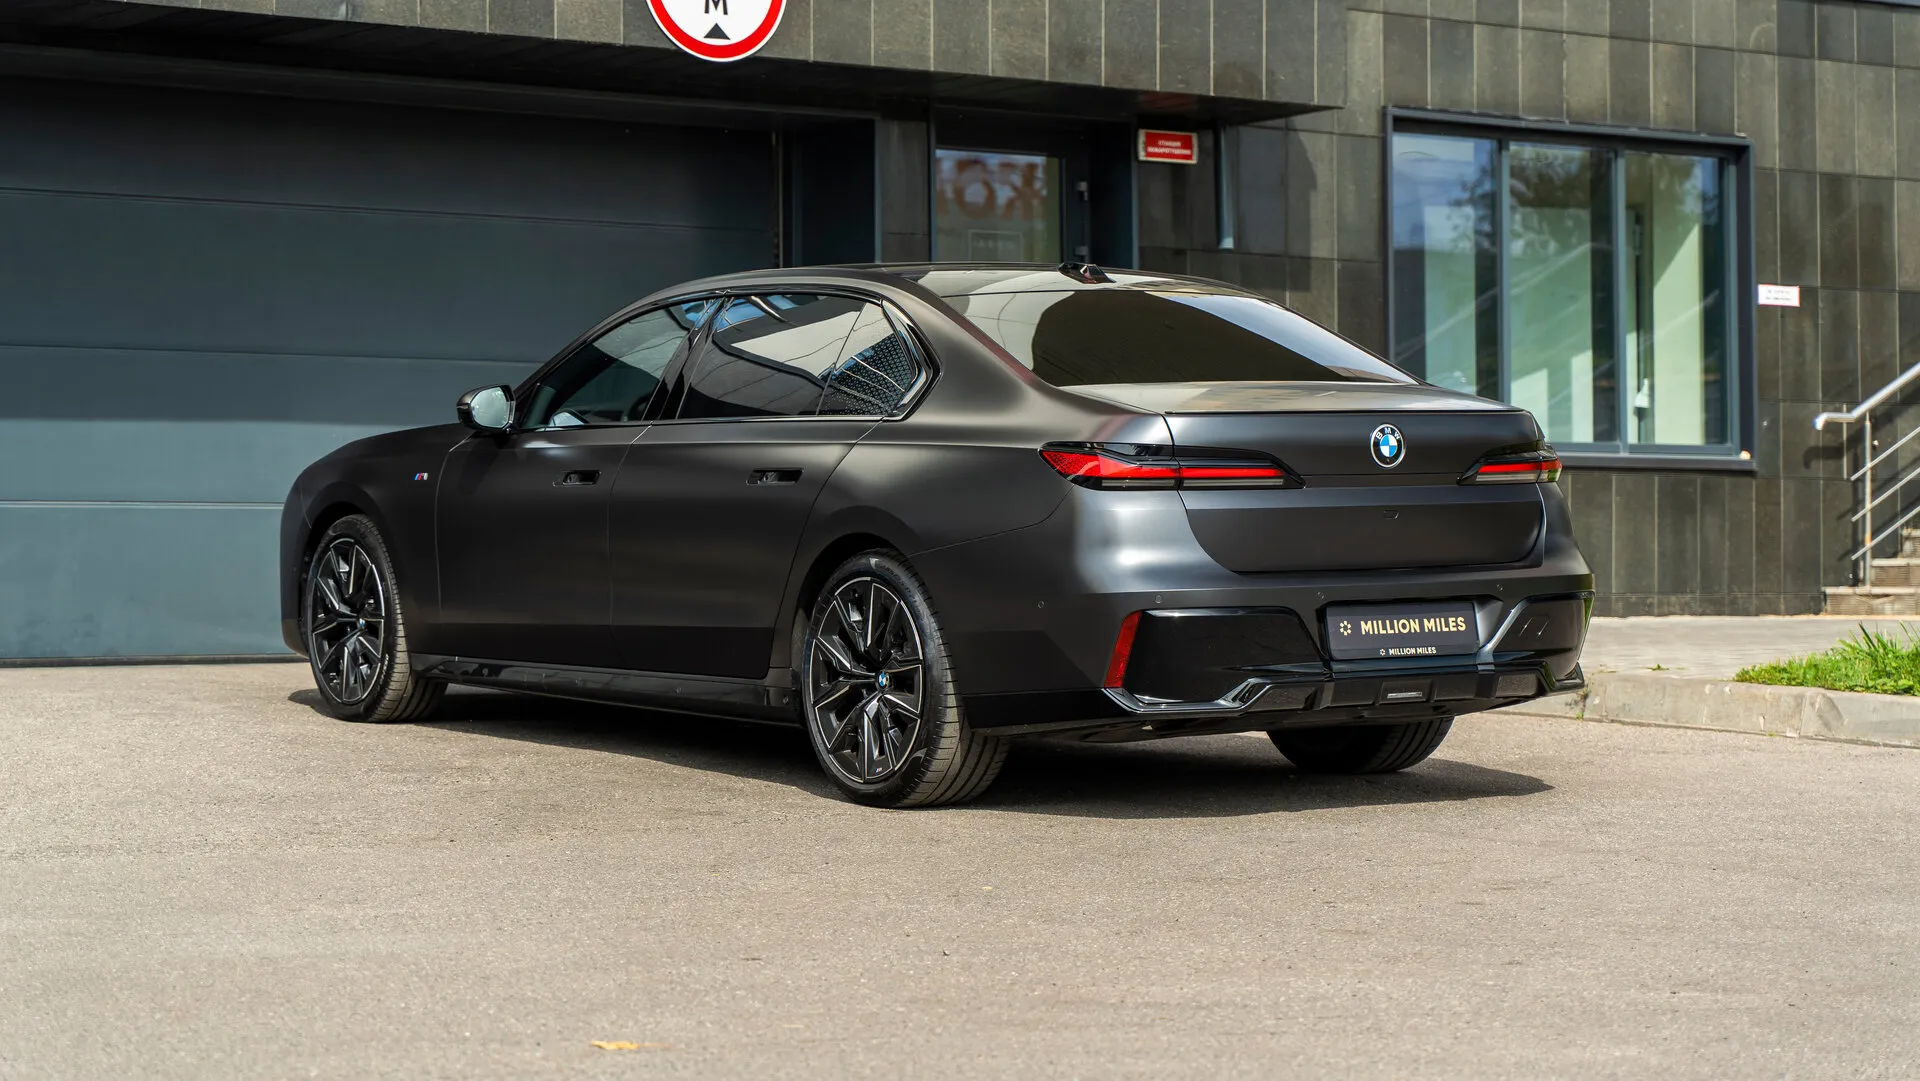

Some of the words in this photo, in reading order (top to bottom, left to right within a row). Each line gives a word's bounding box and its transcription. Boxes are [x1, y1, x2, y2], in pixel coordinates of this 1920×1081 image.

[1376, 427, 1401, 440] BMW
[1360, 618, 1420, 635] MILLION
[1424, 616, 1467, 633] MILES
[1389, 647, 1416, 656] MILLION
[1417, 646, 1437, 655] MILES
